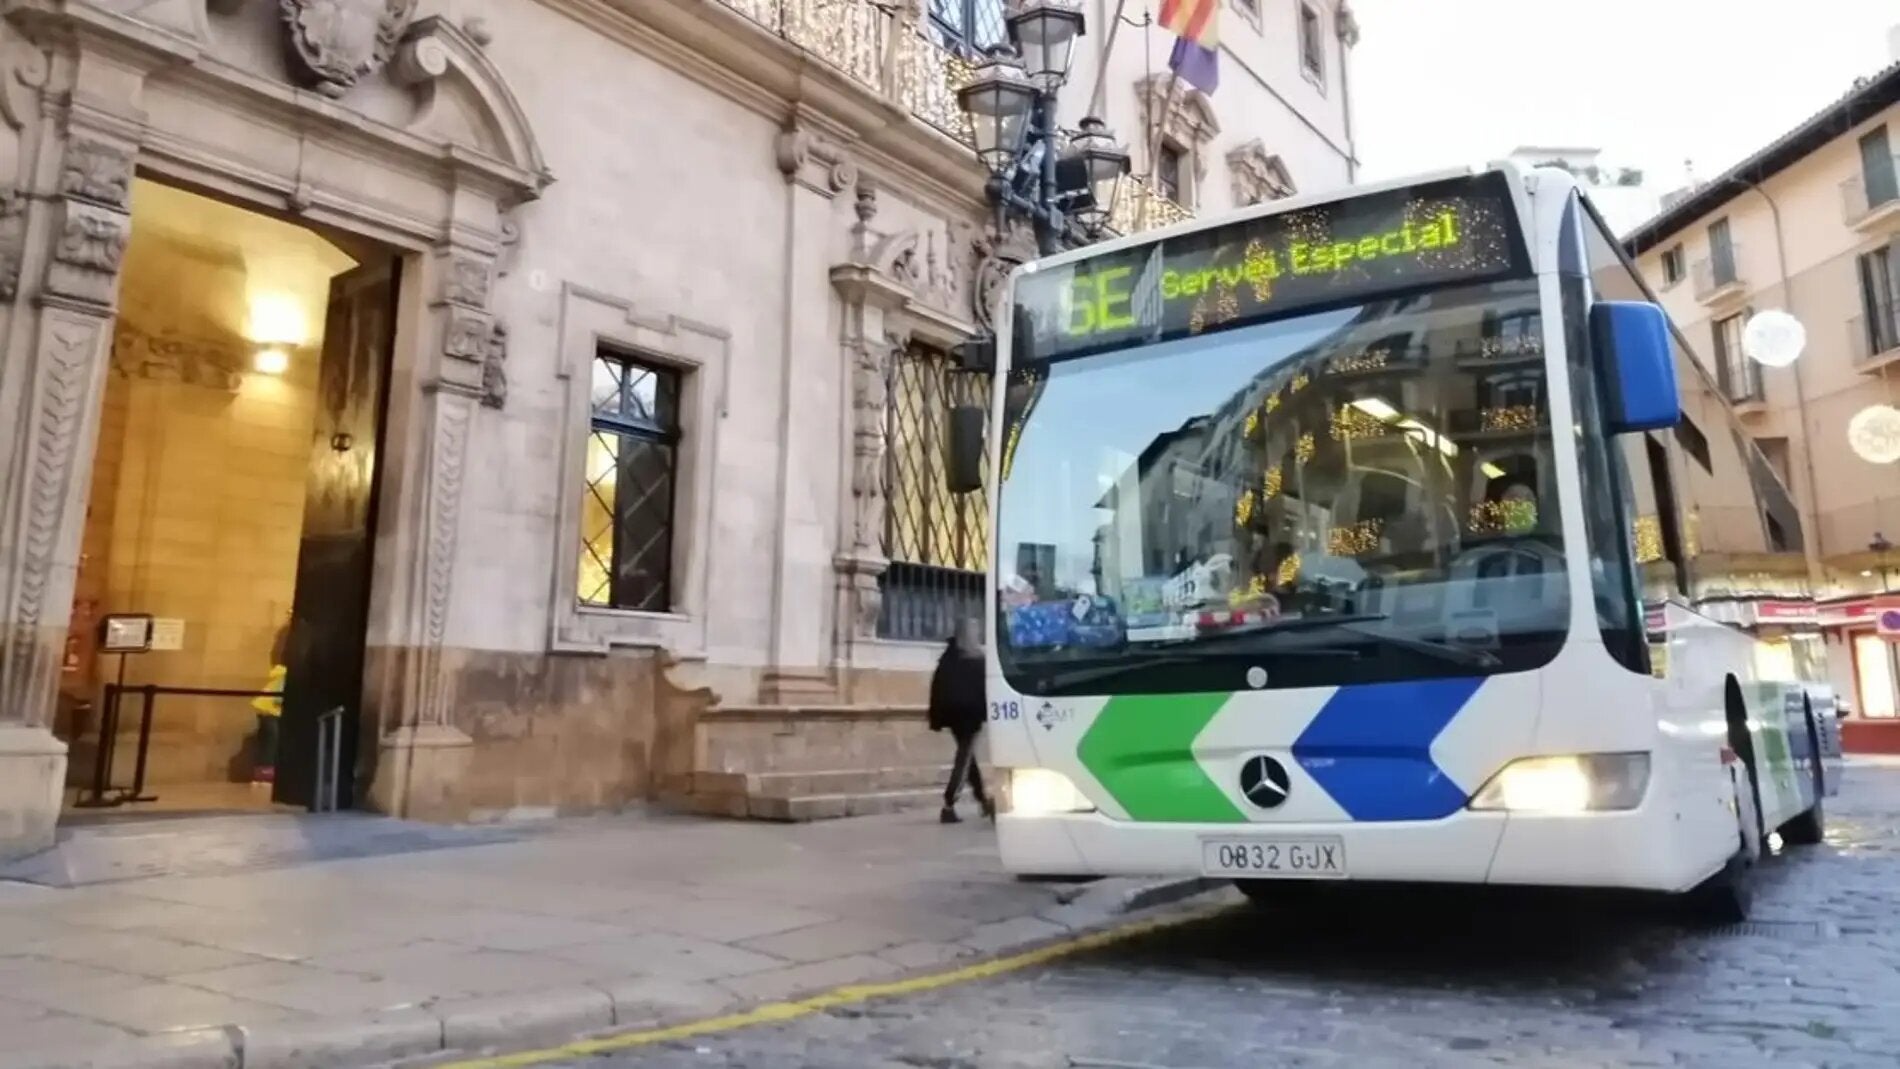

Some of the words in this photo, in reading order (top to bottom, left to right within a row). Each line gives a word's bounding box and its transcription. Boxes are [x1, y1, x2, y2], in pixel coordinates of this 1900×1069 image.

[1290, 212, 1458, 275] Especial
[990, 701, 1019, 720] 318
[1219, 844, 1280, 869] 0832
[1289, 844, 1336, 869] GJX
